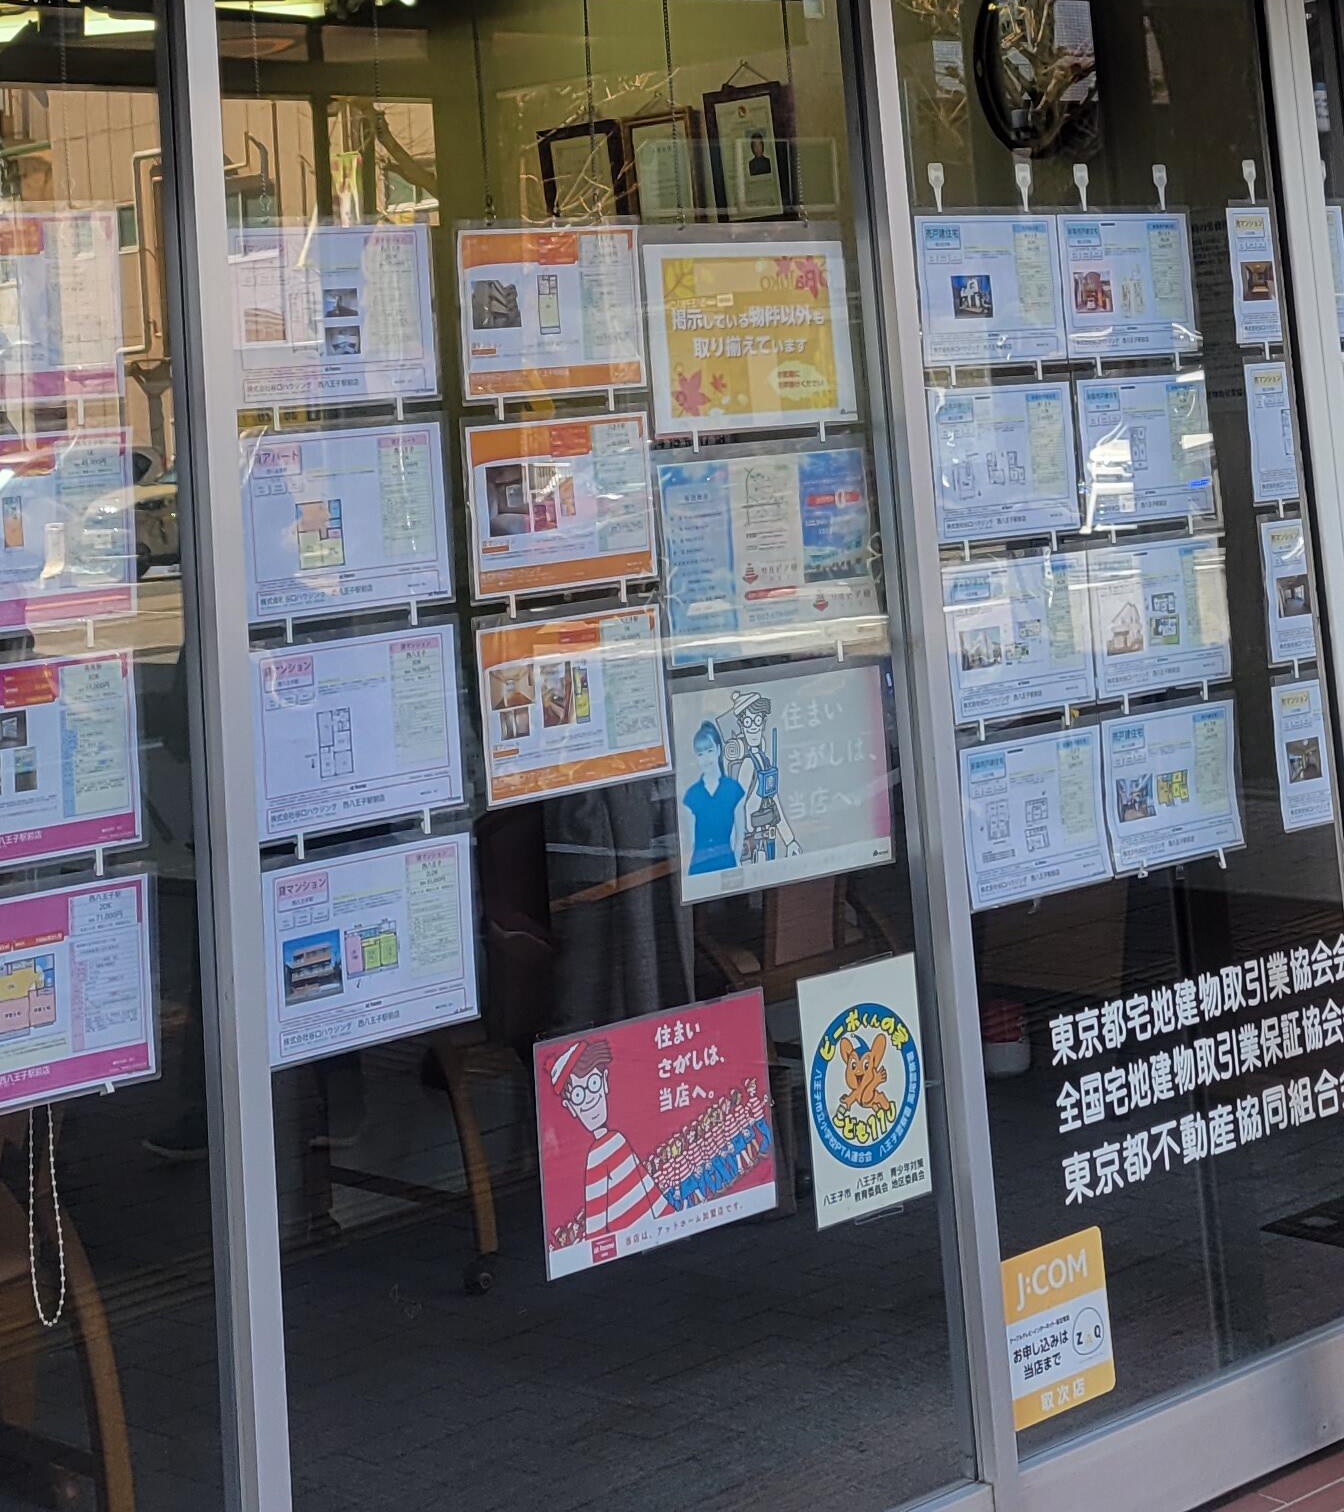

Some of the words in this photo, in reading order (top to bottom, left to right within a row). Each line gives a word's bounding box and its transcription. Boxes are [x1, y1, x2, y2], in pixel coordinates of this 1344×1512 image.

[694, 335, 807, 360] 取り揃えています
[782, 700, 843, 731] 住まい
[654, 1022, 702, 1050] 住まい
[657, 1046, 726, 1080] さがしは、
[658, 1085, 716, 1114] 当店へ。
[856, 1171, 884, 1190] 八王子市
[823, 1187, 852, 1207] 八王子市
[1016, 1248, 1089, 1312] J:COM
[1012, 1329, 1070, 1365] お申し込みは
[1023, 1351, 1063, 1381] 当店まで
[1040, 1377, 1086, 1413] 取次店
